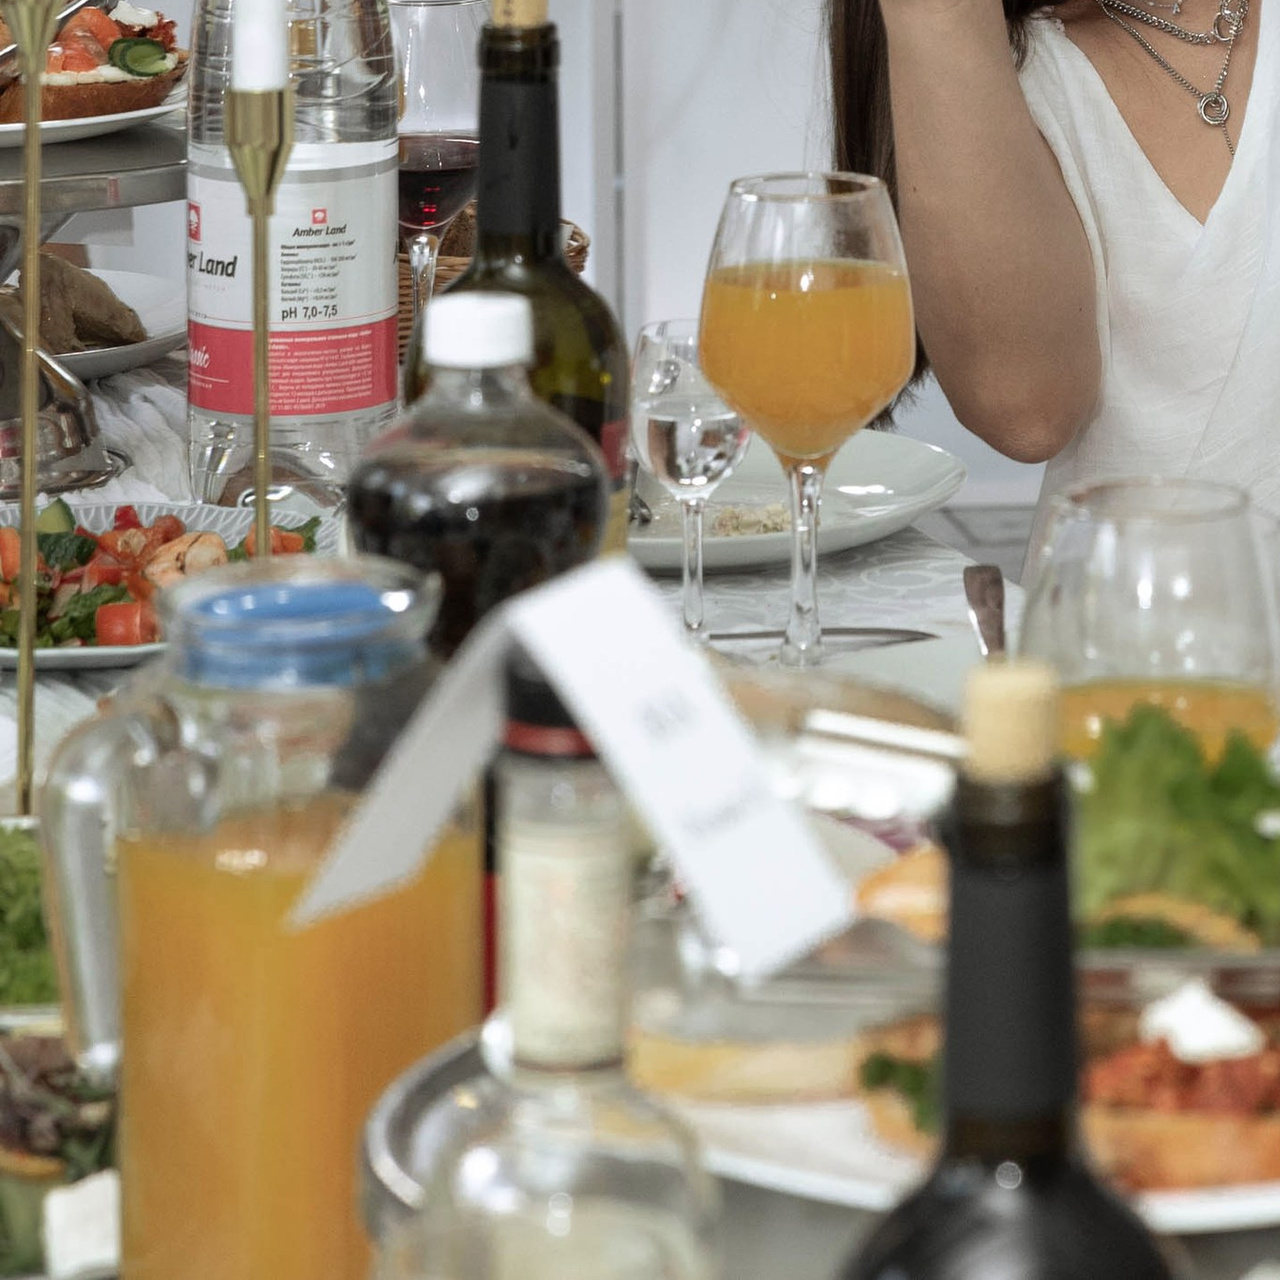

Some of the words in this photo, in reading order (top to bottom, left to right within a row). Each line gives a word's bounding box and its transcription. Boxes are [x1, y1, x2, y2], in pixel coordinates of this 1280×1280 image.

[292, 226, 324, 237] Amber
[325, 223, 347, 236] Land
[199, 250, 238, 278] Land
[281, 306, 298, 321] pH
